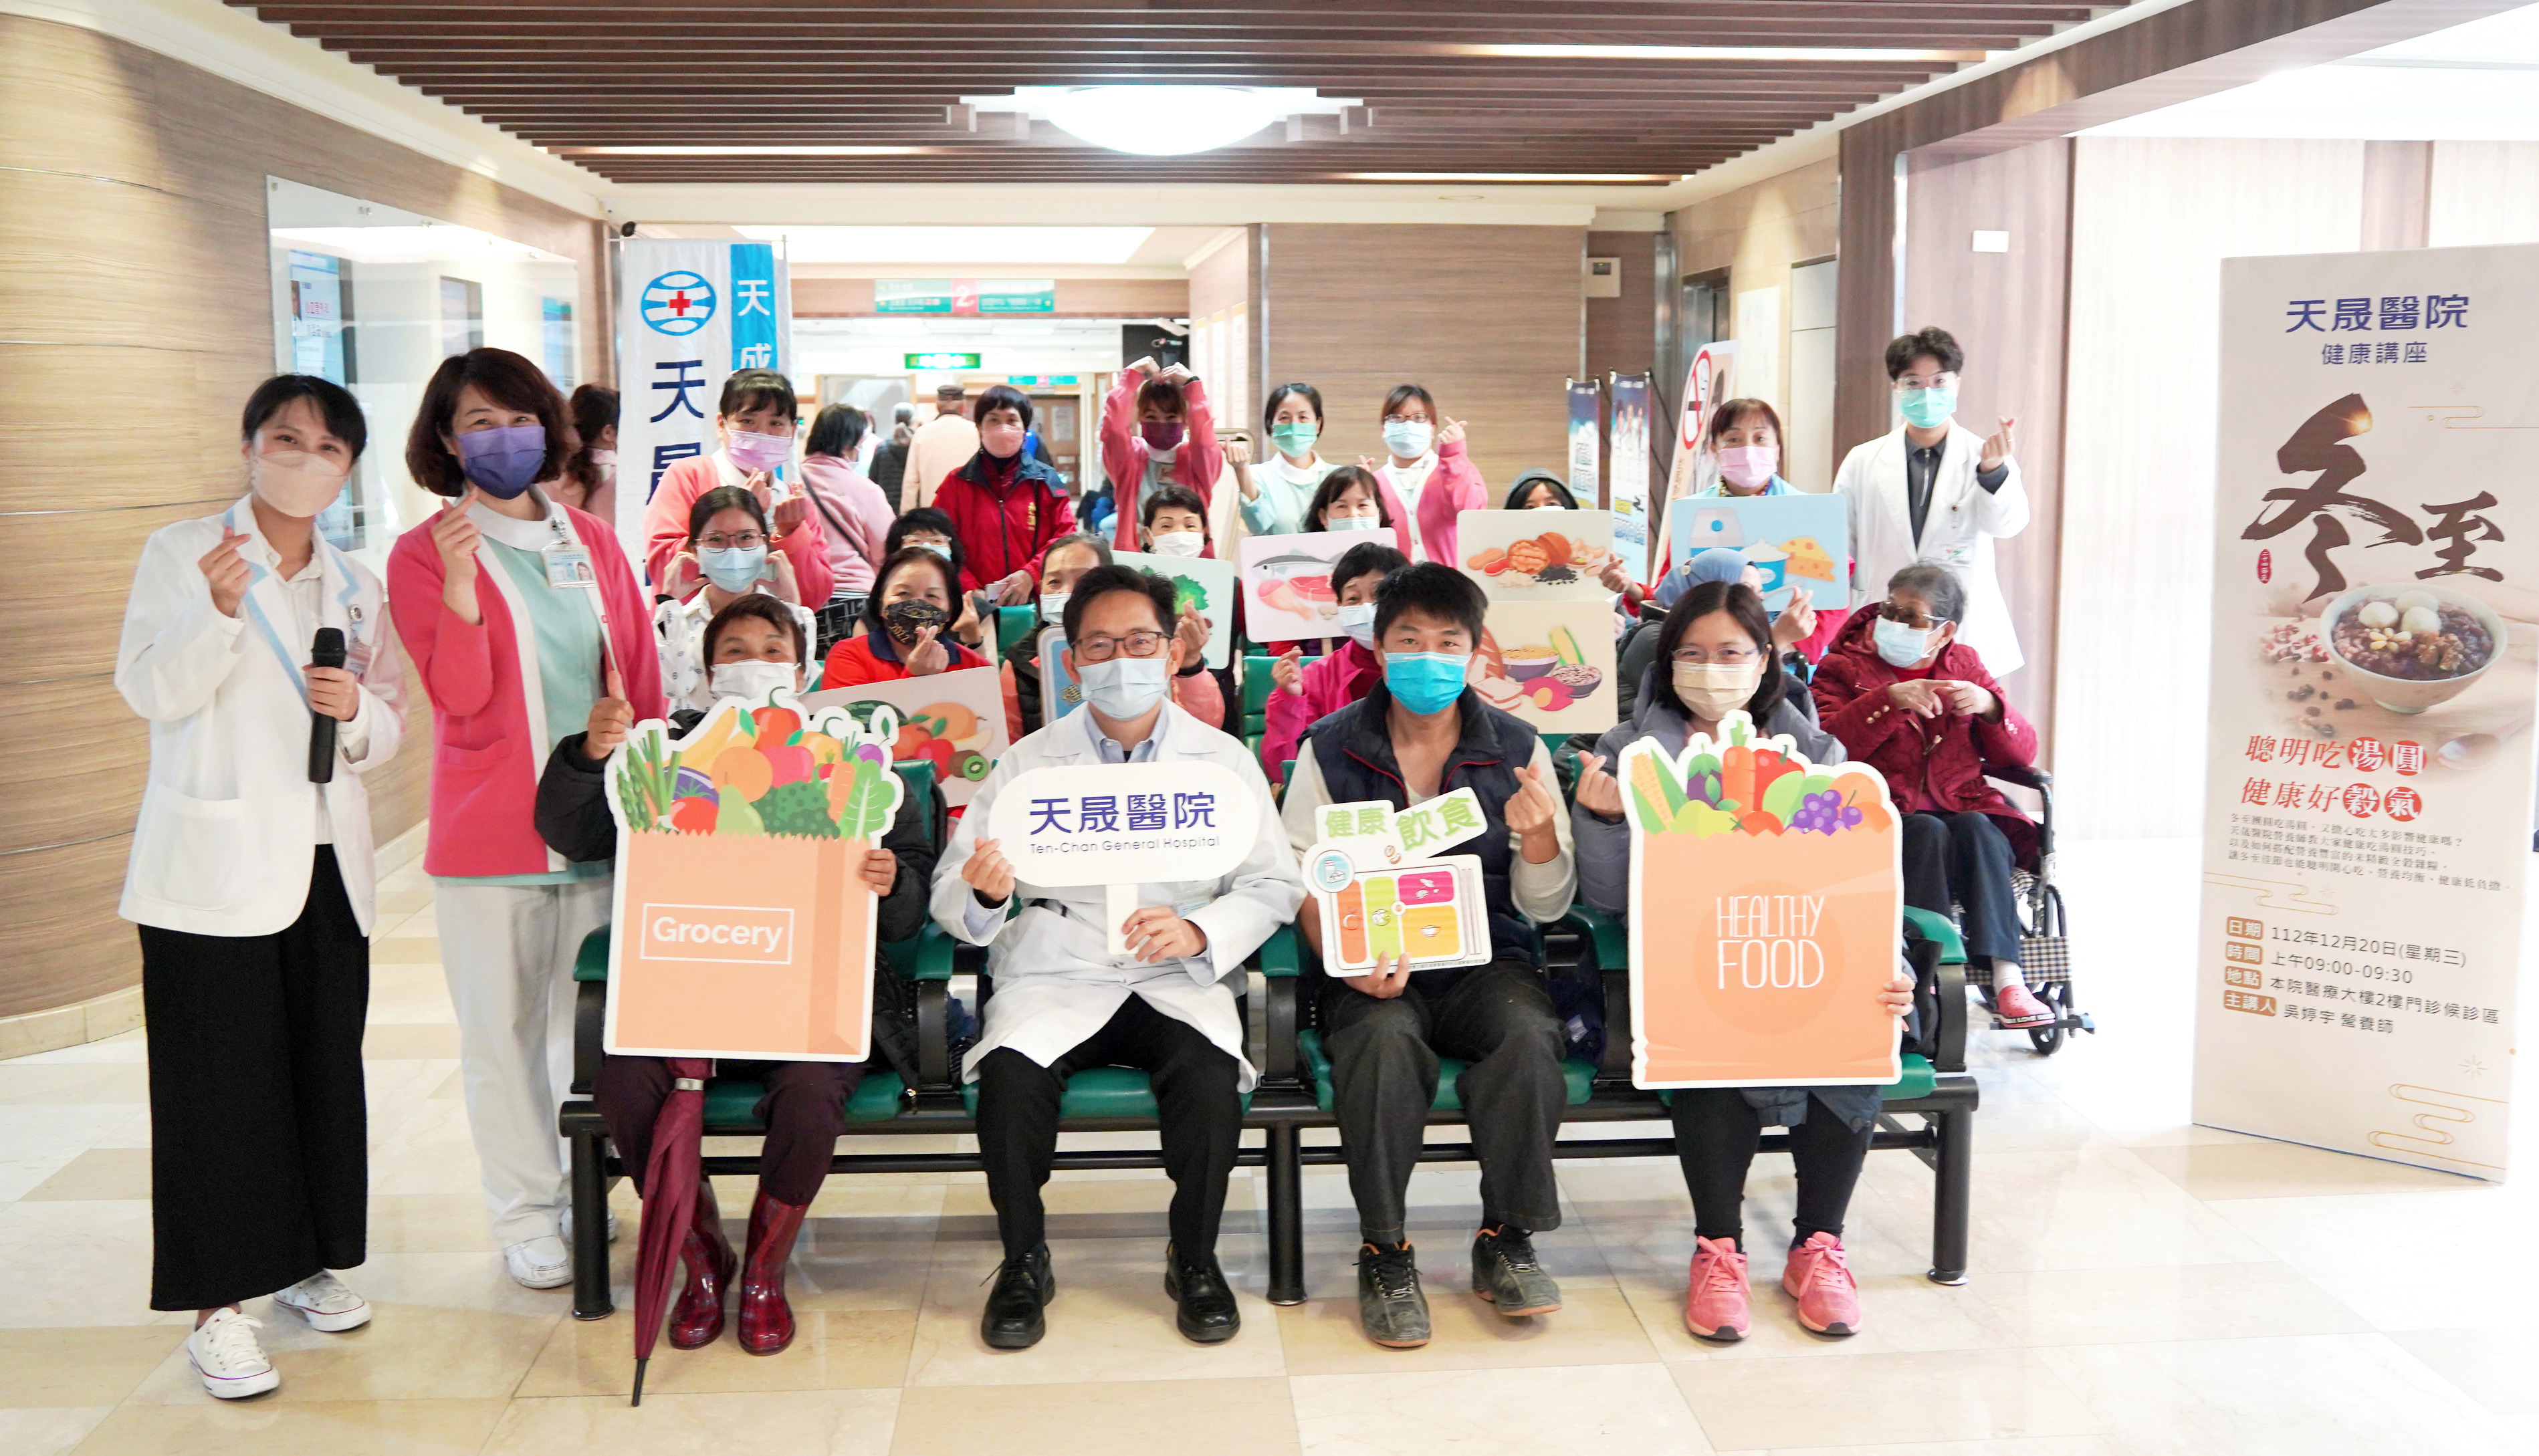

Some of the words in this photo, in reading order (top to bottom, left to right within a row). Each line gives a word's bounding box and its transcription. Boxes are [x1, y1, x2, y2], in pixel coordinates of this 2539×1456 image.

[2285, 294, 2469, 333] 天晟醫院
[2321, 341, 2429, 365] 健康講座
[2241, 392, 2505, 604] 冬至
[2245, 735, 2425, 774] 聰明吃湯圓
[1030, 792, 1216, 835] 天晟醫院
[1325, 806, 1388, 838] 健康
[1395, 796, 1480, 851] 飲食
[1030, 841, 1098, 854] Ten-Chan
[1103, 838, 1160, 851] General
[1164, 836, 1220, 850] Hospital
[653, 916, 784, 953] Grocery
[1717, 895, 1825, 937] HEALTHY
[1717, 939, 1824, 989] FOOD
[2226, 944, 2261, 962] 時間
[2270, 951, 2413, 983] 上午09:00-09:30
[2228, 919, 2262, 938] 日期
[2272, 927, 2467, 968] 112年12月20日(星期三)
[2225, 968, 2259, 987] 地點
[2270, 977, 2500, 1024] 本院醫療大樓2樓門診候診區
[2225, 993, 2276, 1015] 主講人
[2341, 1012, 2394, 1034] 營養師
